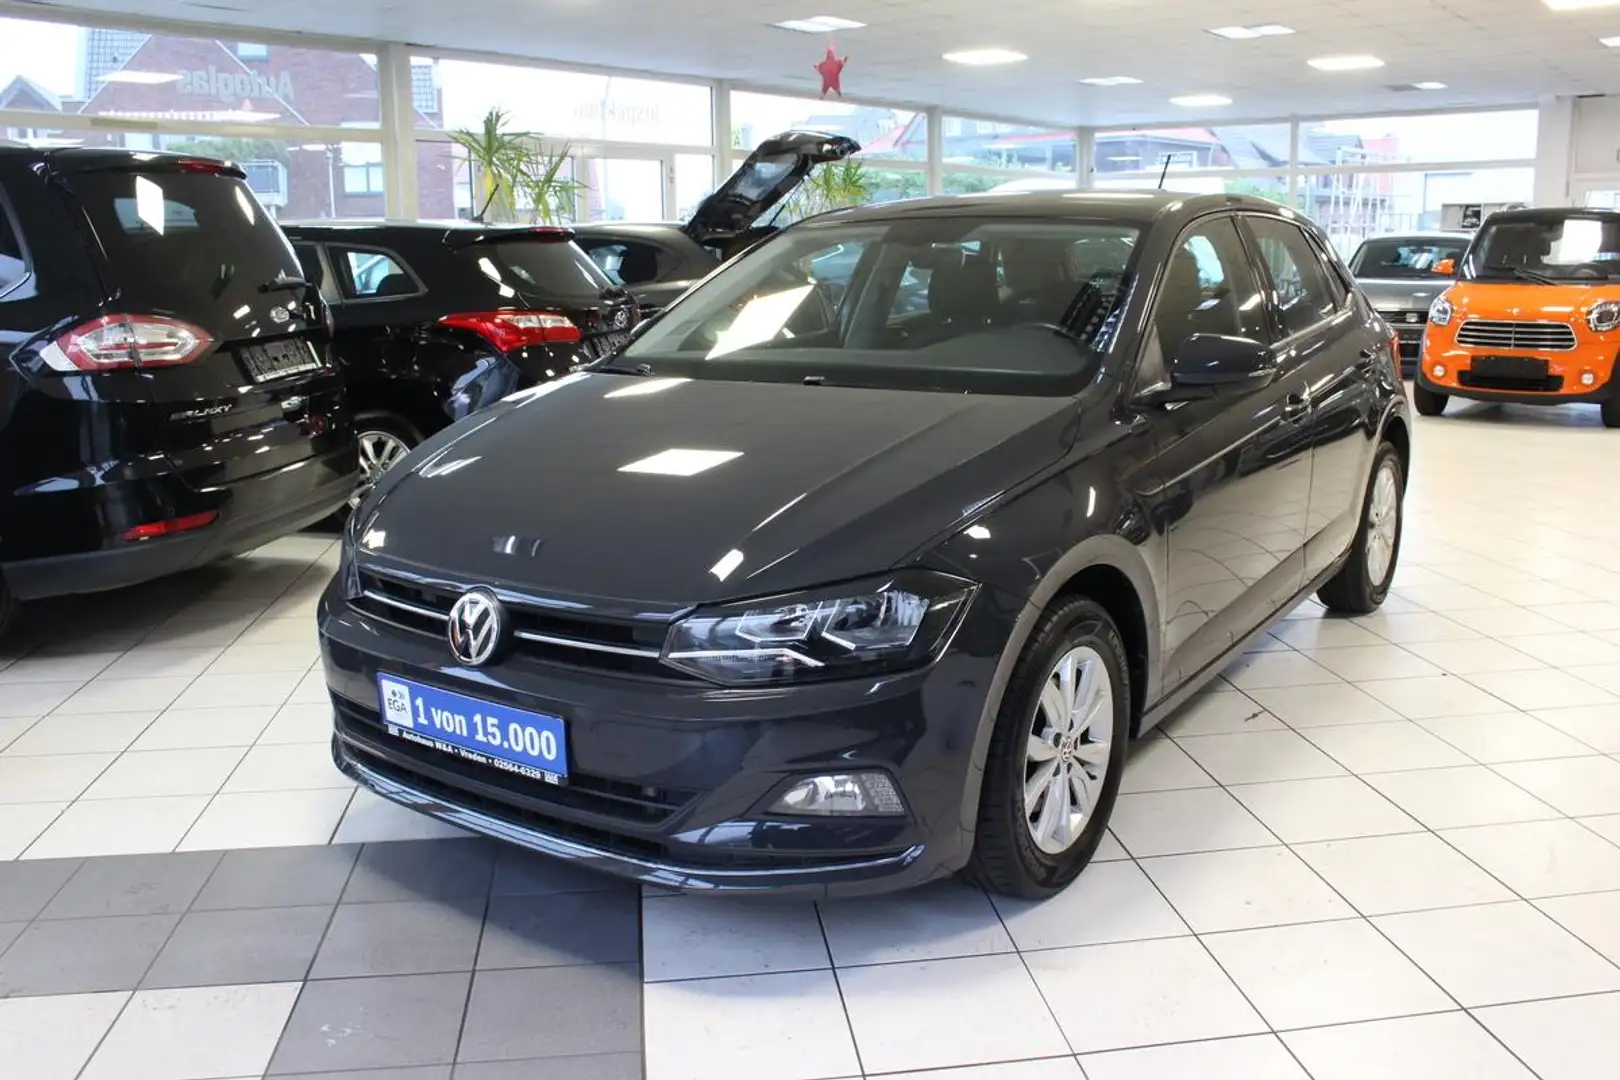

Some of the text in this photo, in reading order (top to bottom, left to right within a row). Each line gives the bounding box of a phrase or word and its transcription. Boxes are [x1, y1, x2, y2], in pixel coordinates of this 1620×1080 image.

[387, 696, 408, 714] EGA
[415, 696, 557, 761] 1 von 15.000
